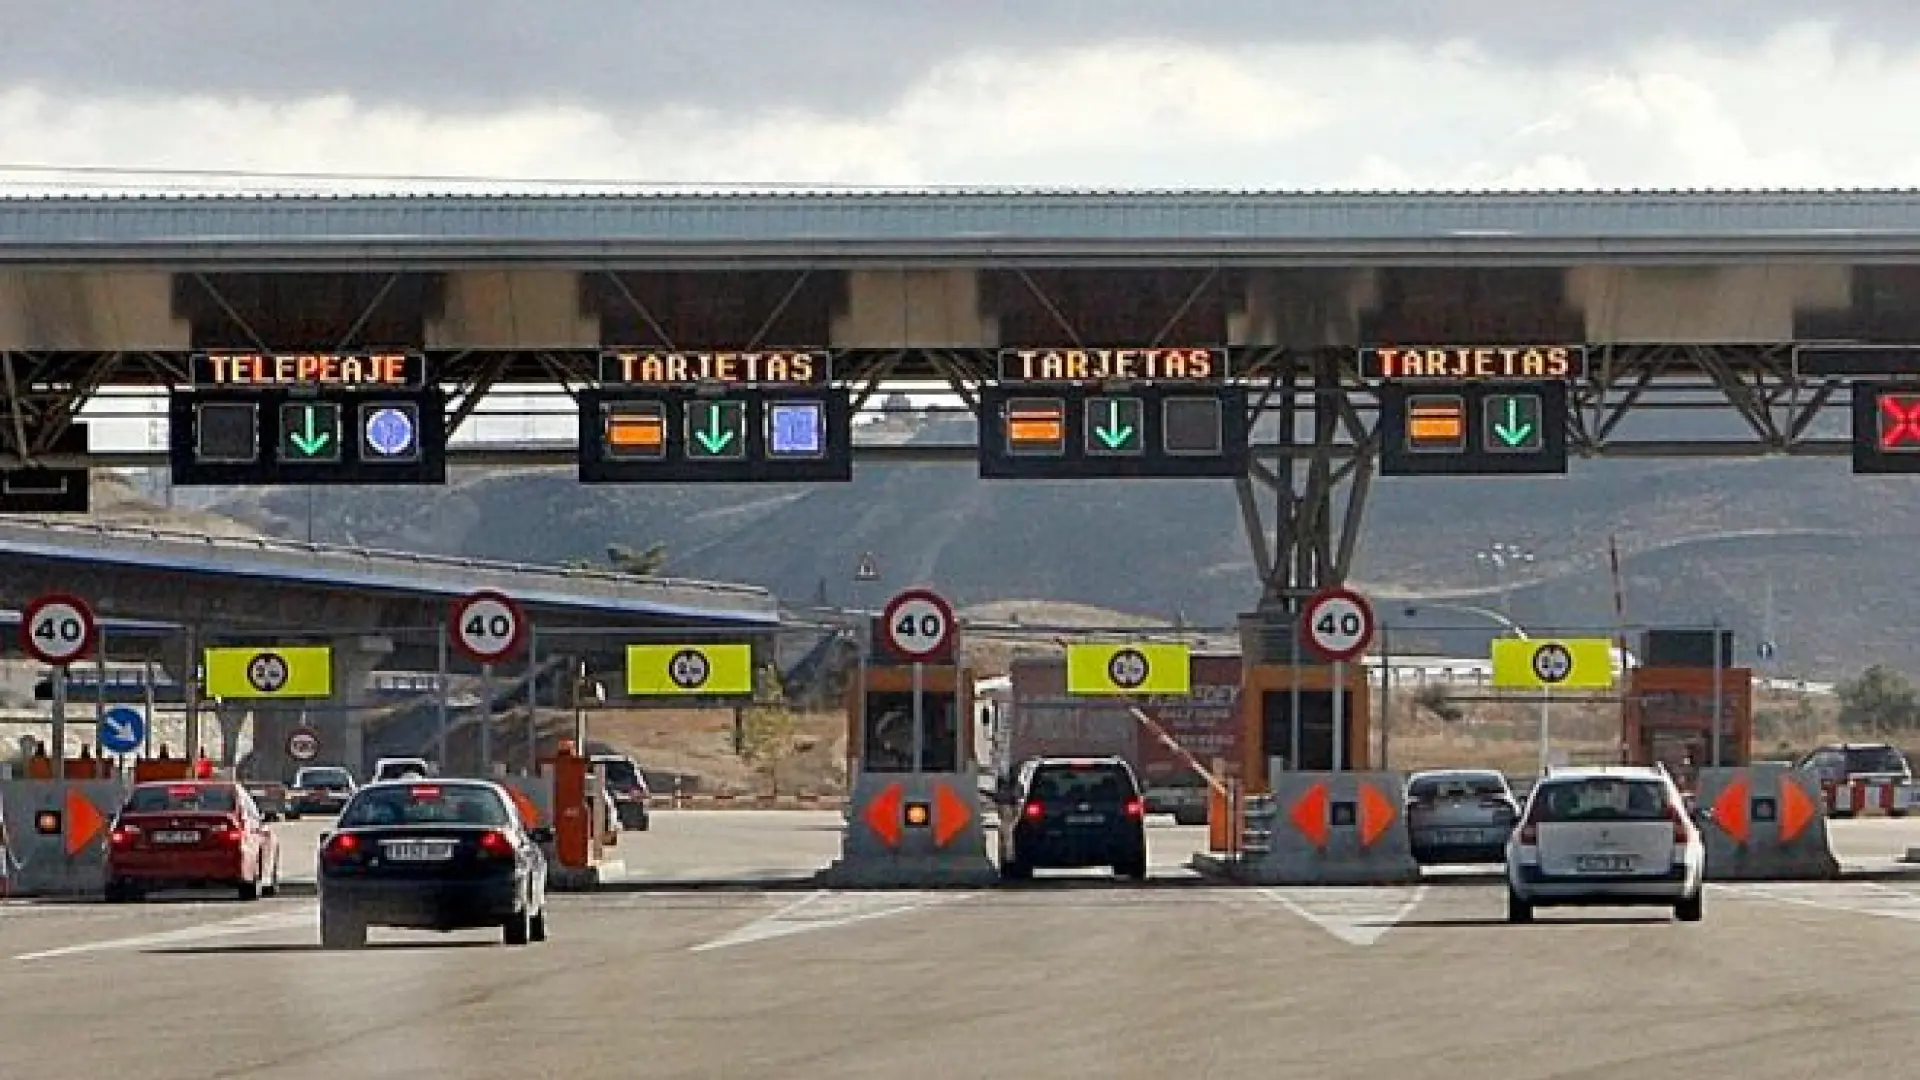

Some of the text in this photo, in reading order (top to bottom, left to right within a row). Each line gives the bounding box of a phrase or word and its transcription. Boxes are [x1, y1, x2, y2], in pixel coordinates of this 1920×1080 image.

[209, 355, 405, 383] TELEPEAJE
[619, 353, 813, 381] TARJETAS
[1018, 350, 1210, 378] TARJETAS
[1377, 347, 1569, 375] TARJETAS
[34, 618, 81, 642] 40
[465, 615, 509, 638] 40
[896, 614, 940, 637] 40
[1316, 612, 1360, 636] 40
